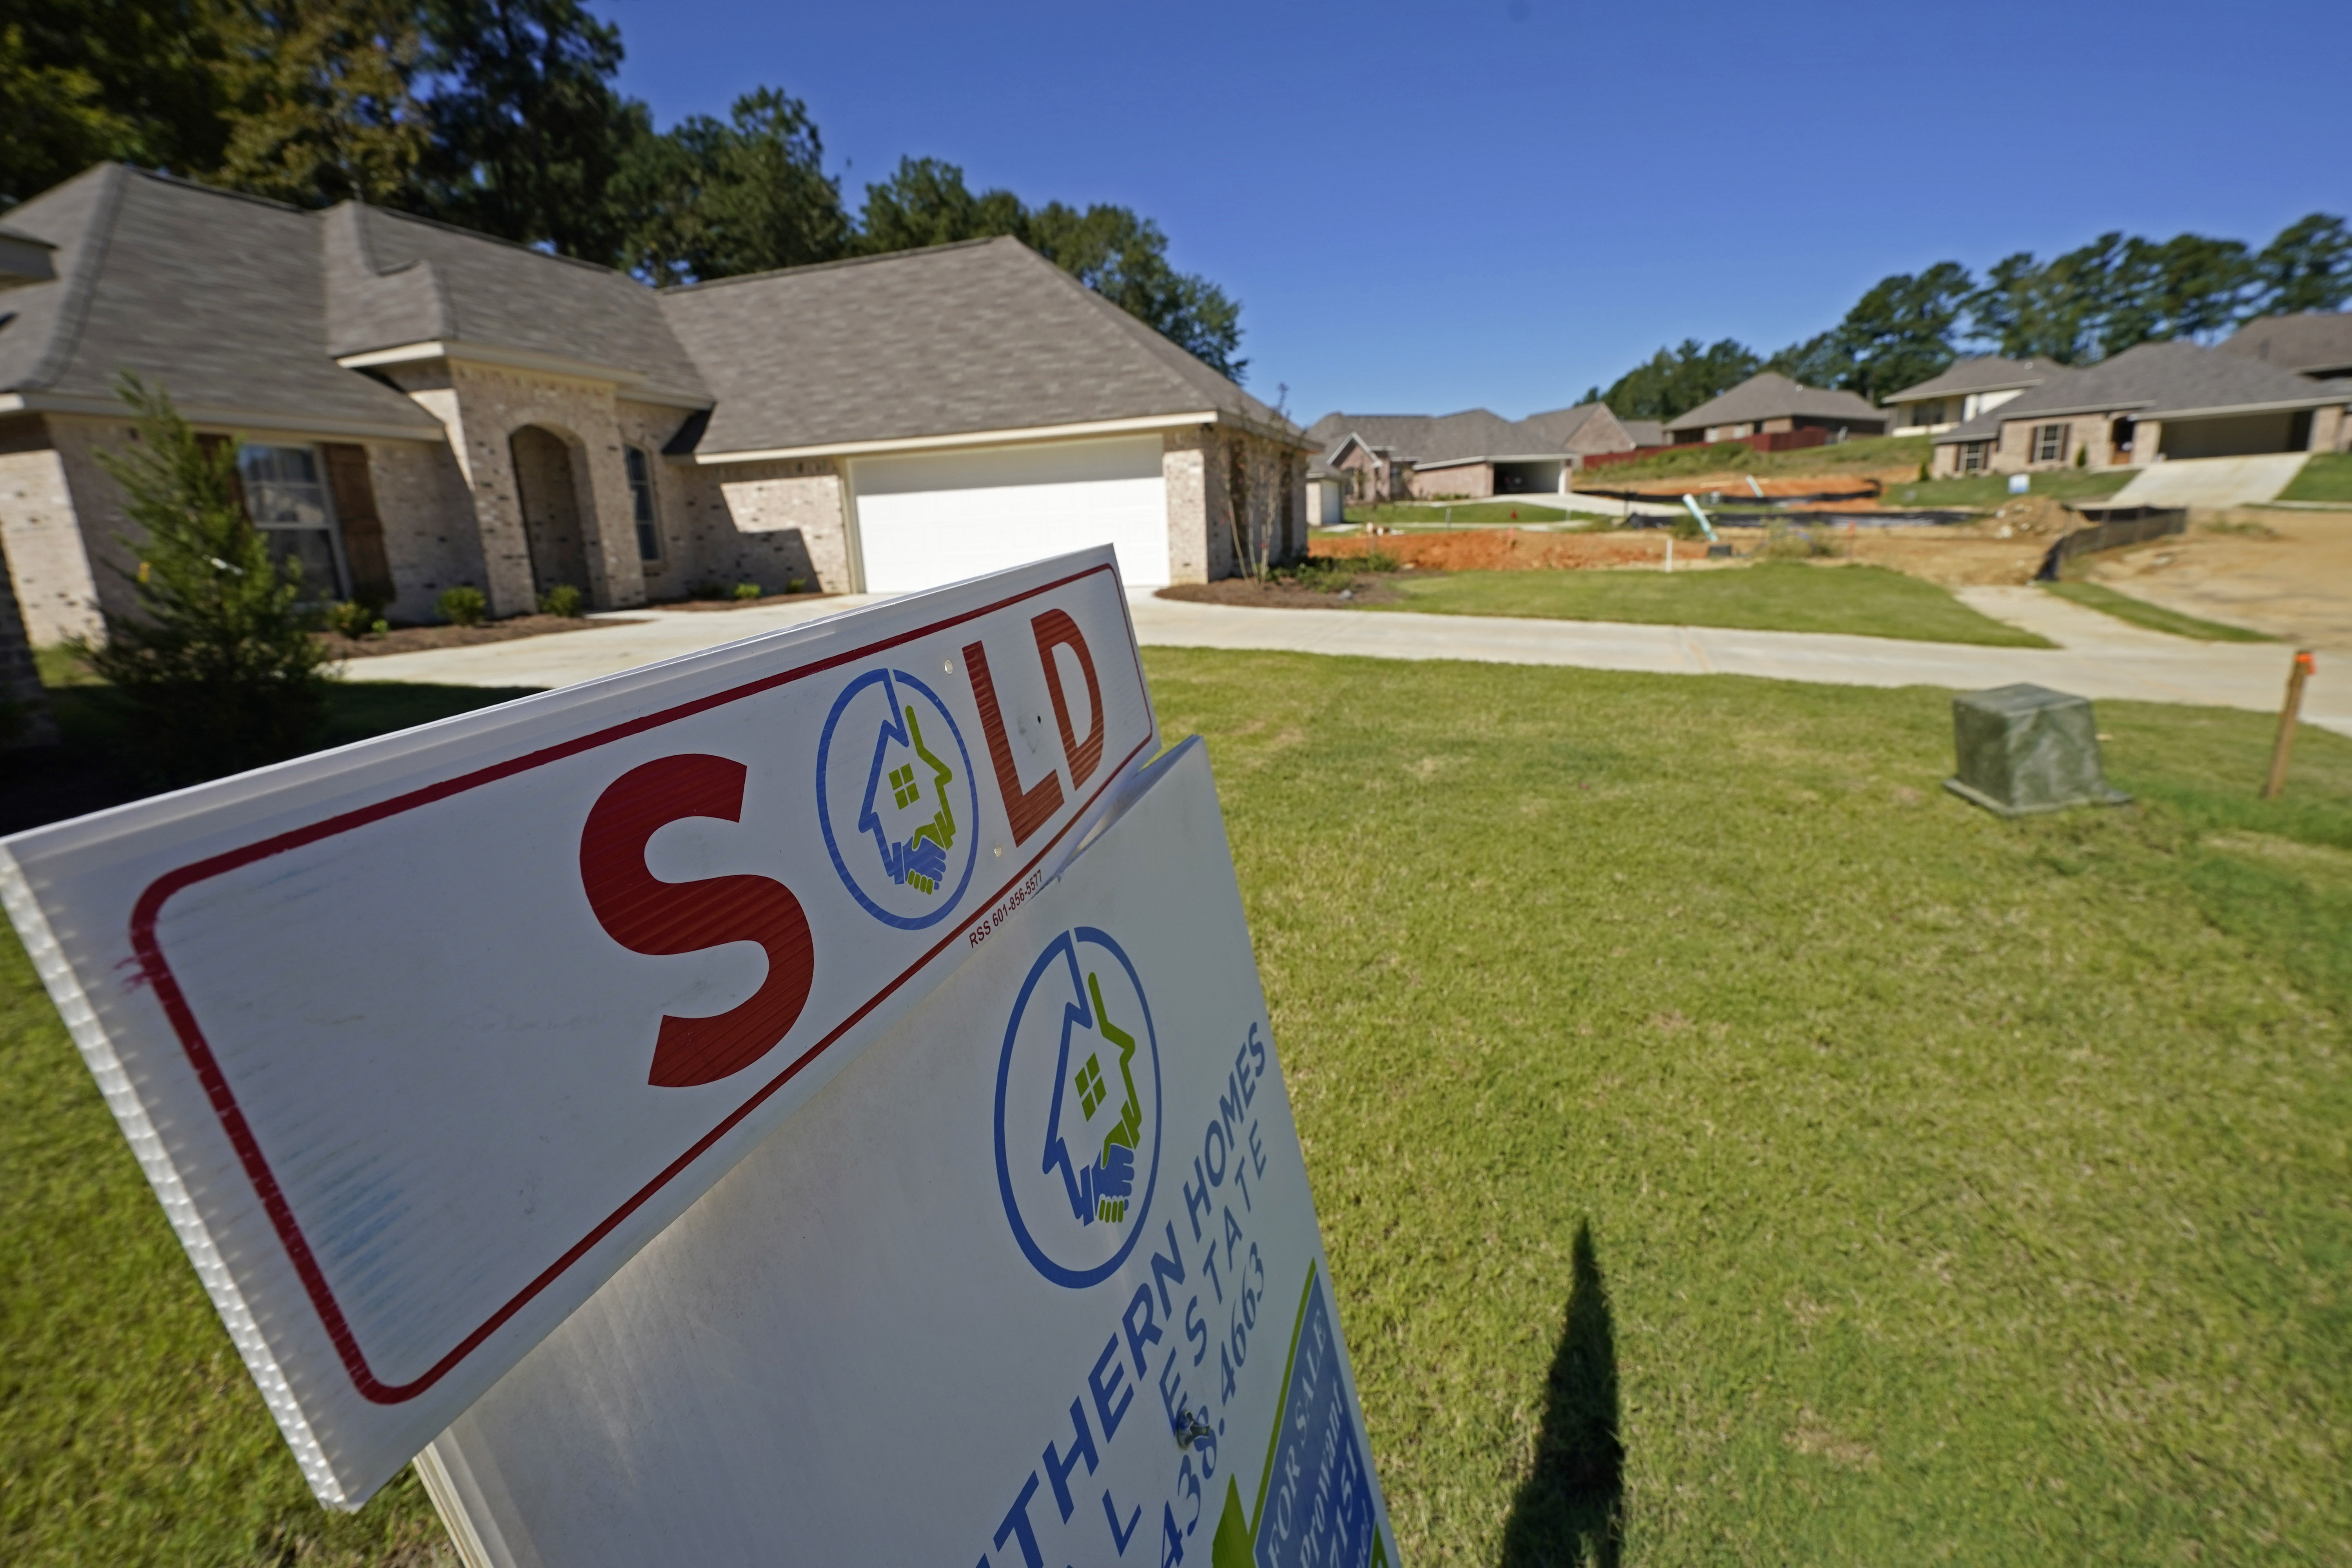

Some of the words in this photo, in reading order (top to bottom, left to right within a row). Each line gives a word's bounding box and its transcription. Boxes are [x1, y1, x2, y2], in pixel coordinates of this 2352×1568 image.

[969, 920, 991, 948] RSS
[992, 869, 1043, 927] 601-856-5577
[975, 1219, 1185, 1568] THERN
[1183, 1022, 1265, 1244] HOMES
[1159, 1118, 1267, 1438] ESTATE
[1268, 1444, 1301, 1568] FOR
[1295, 1309, 1327, 1449] SALE
